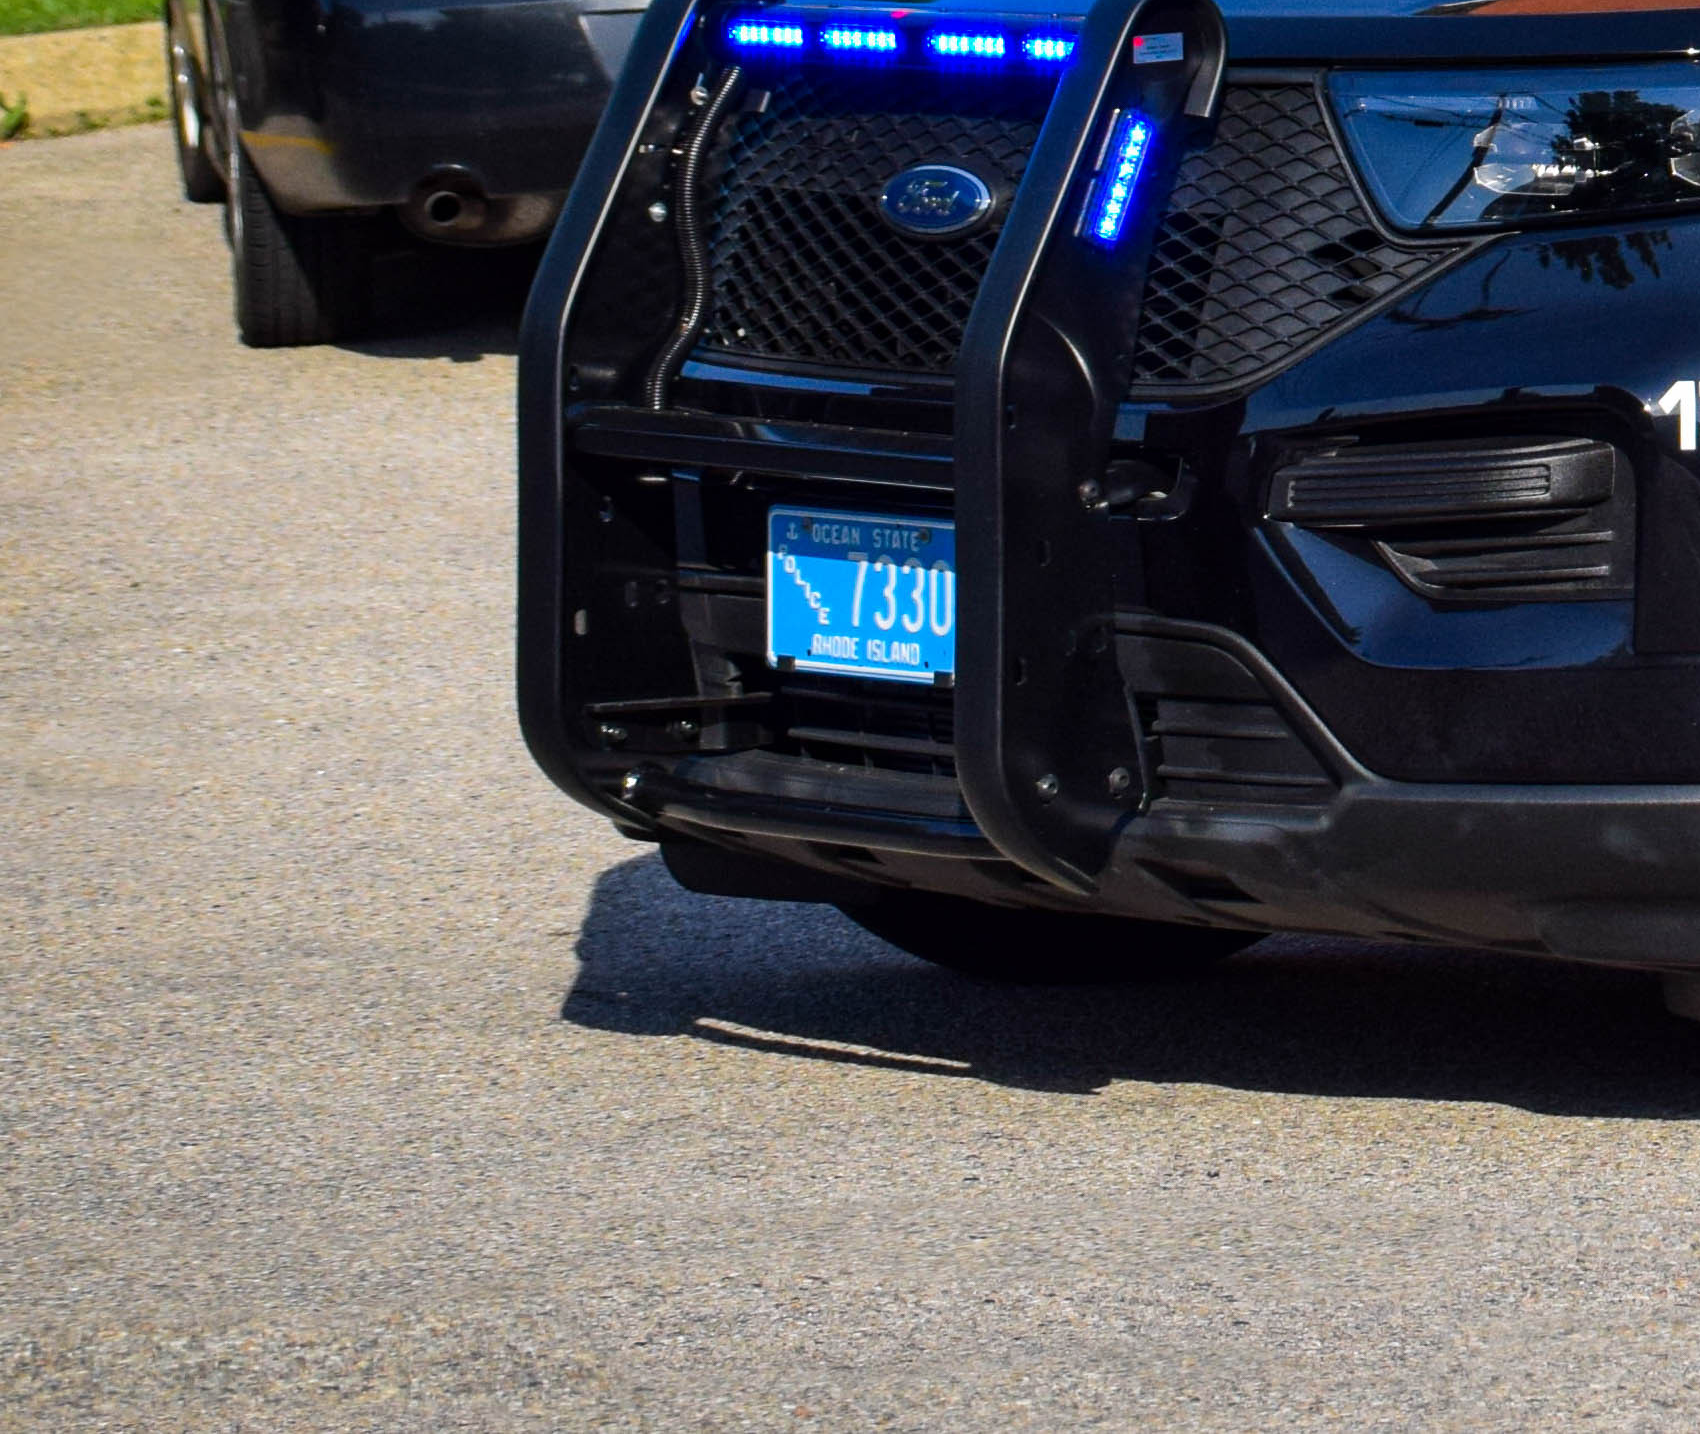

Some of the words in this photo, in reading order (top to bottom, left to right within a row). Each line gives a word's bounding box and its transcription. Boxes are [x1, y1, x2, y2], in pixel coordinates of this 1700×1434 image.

[812, 523, 860, 546] OCEAN
[872, 528, 921, 552] STATE
[777, 544, 831, 626] POLICE
[848, 551, 953, 637] 7330
[810, 634, 859, 660] RHODE
[867, 639, 920, 665] ISLAND
